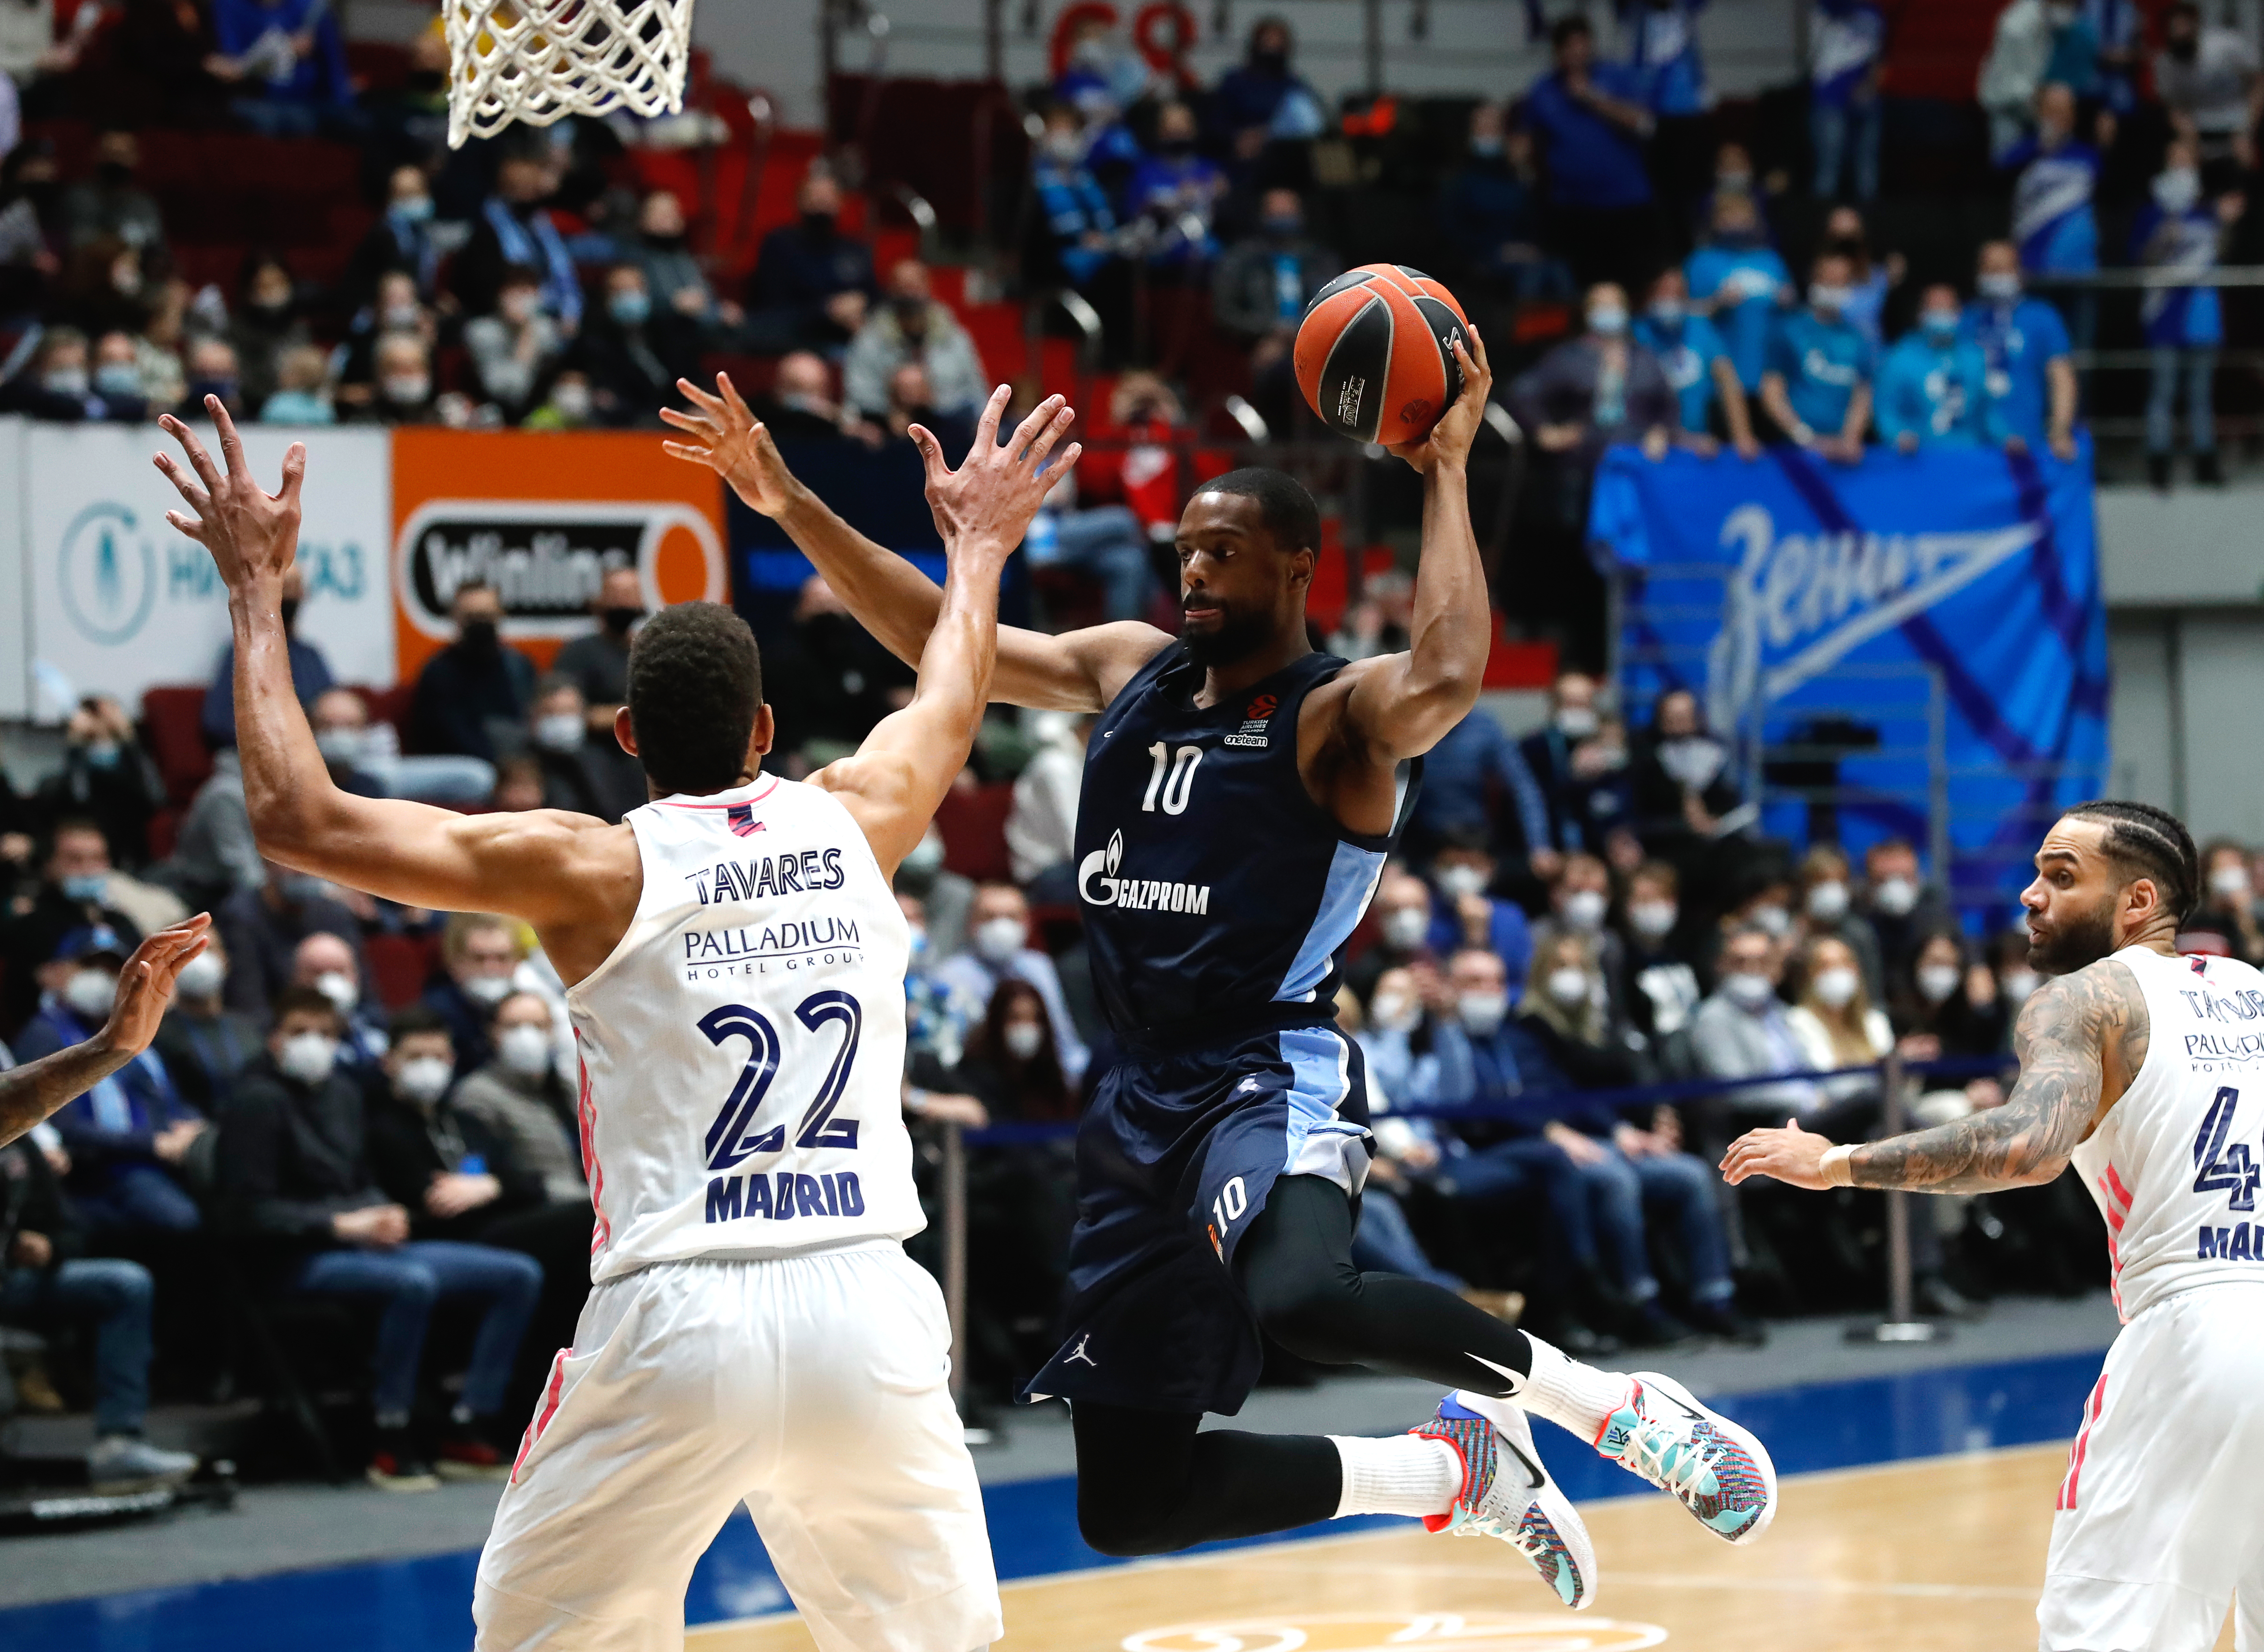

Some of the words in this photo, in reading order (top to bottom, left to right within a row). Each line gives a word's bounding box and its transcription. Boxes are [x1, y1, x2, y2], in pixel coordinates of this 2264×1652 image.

[1142, 741, 1203, 815] 10
[685, 848, 844, 905] TAVARES
[1118, 879, 1210, 915] GAZPROM
[684, 917, 859, 958] PALLADIUM
[688, 963, 765, 981] HOTEL
[787, 952, 864, 970] GROUP
[2185, 1032, 2264, 1056] PALLADI
[696, 990, 862, 1170] 22
[2194, 1086, 2264, 1211] 4
[706, 1172, 865, 1224] MADRID
[1213, 1176, 1247, 1238] 10
